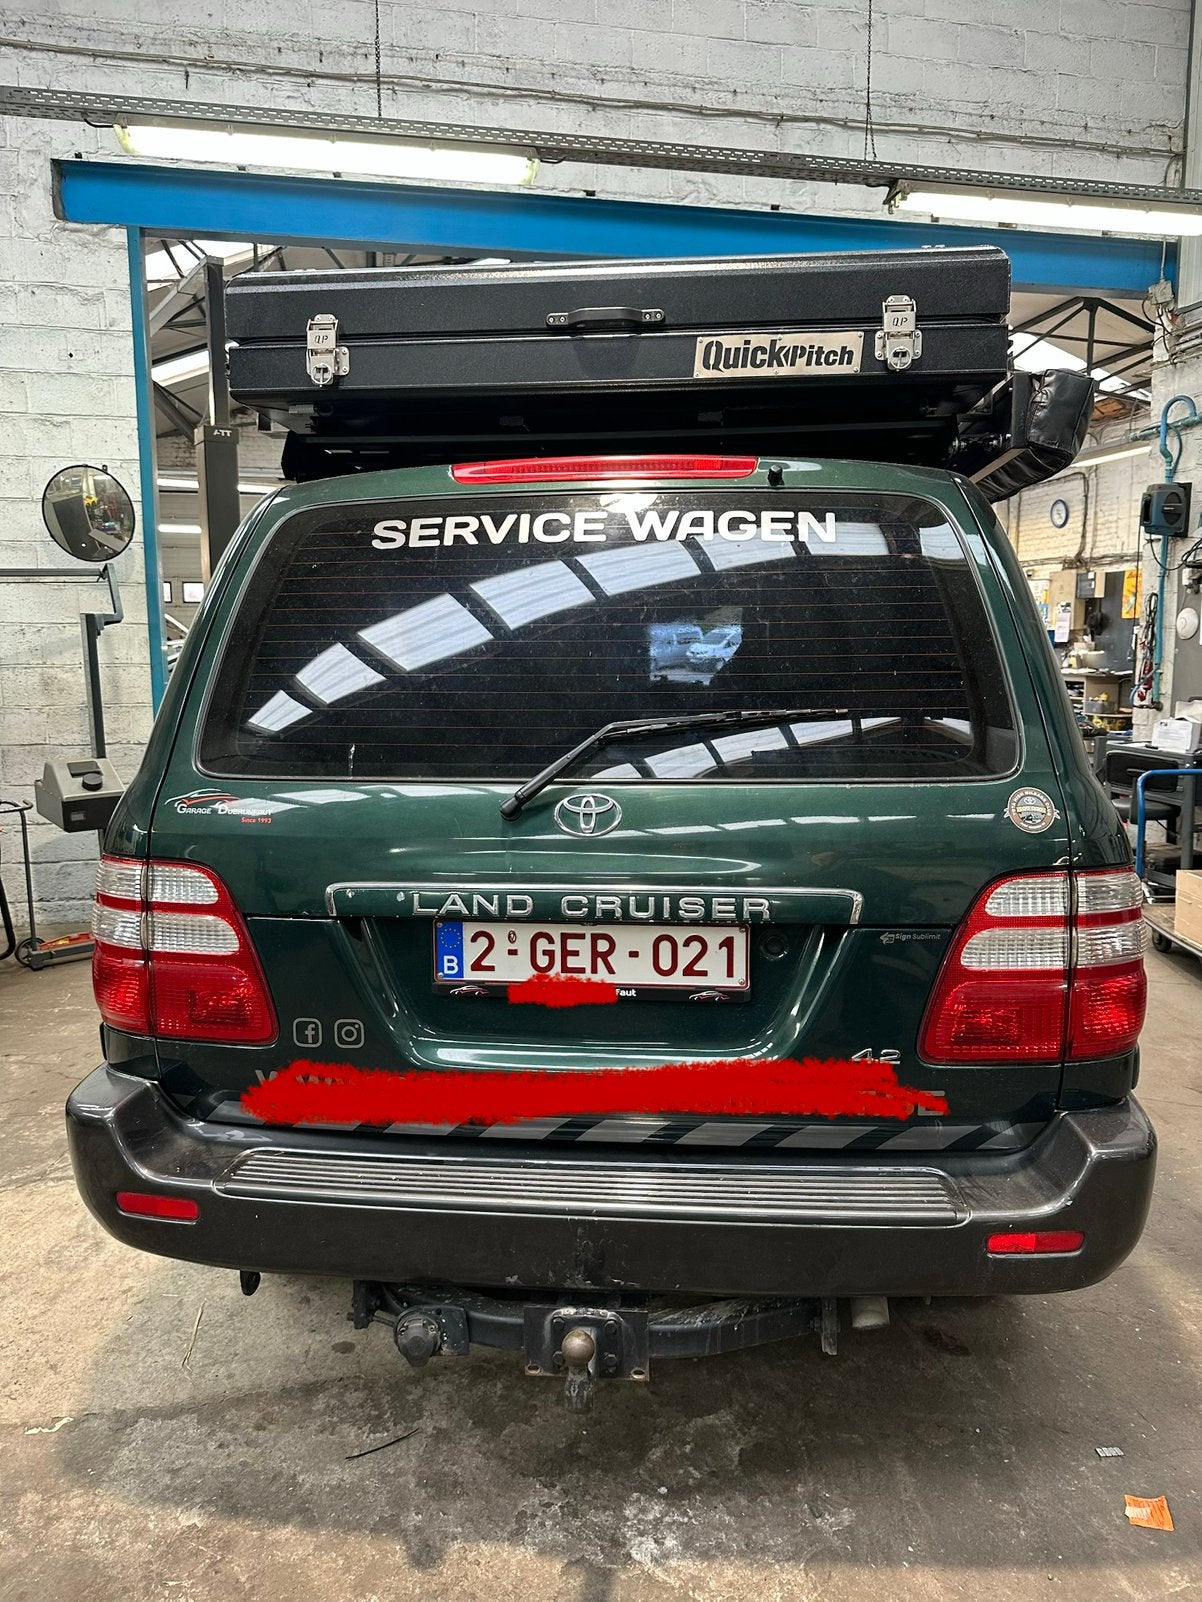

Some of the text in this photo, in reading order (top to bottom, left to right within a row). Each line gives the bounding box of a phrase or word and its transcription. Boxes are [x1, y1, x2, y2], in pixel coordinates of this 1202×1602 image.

[702, 339, 854, 373] QuickPitch
[371, 510, 837, 550] SERVICE WAGEN
[412, 893, 771, 920] LAND CRUISER
[443, 955, 459, 975] B
[470, 930, 735, 978] 2-GER-021
